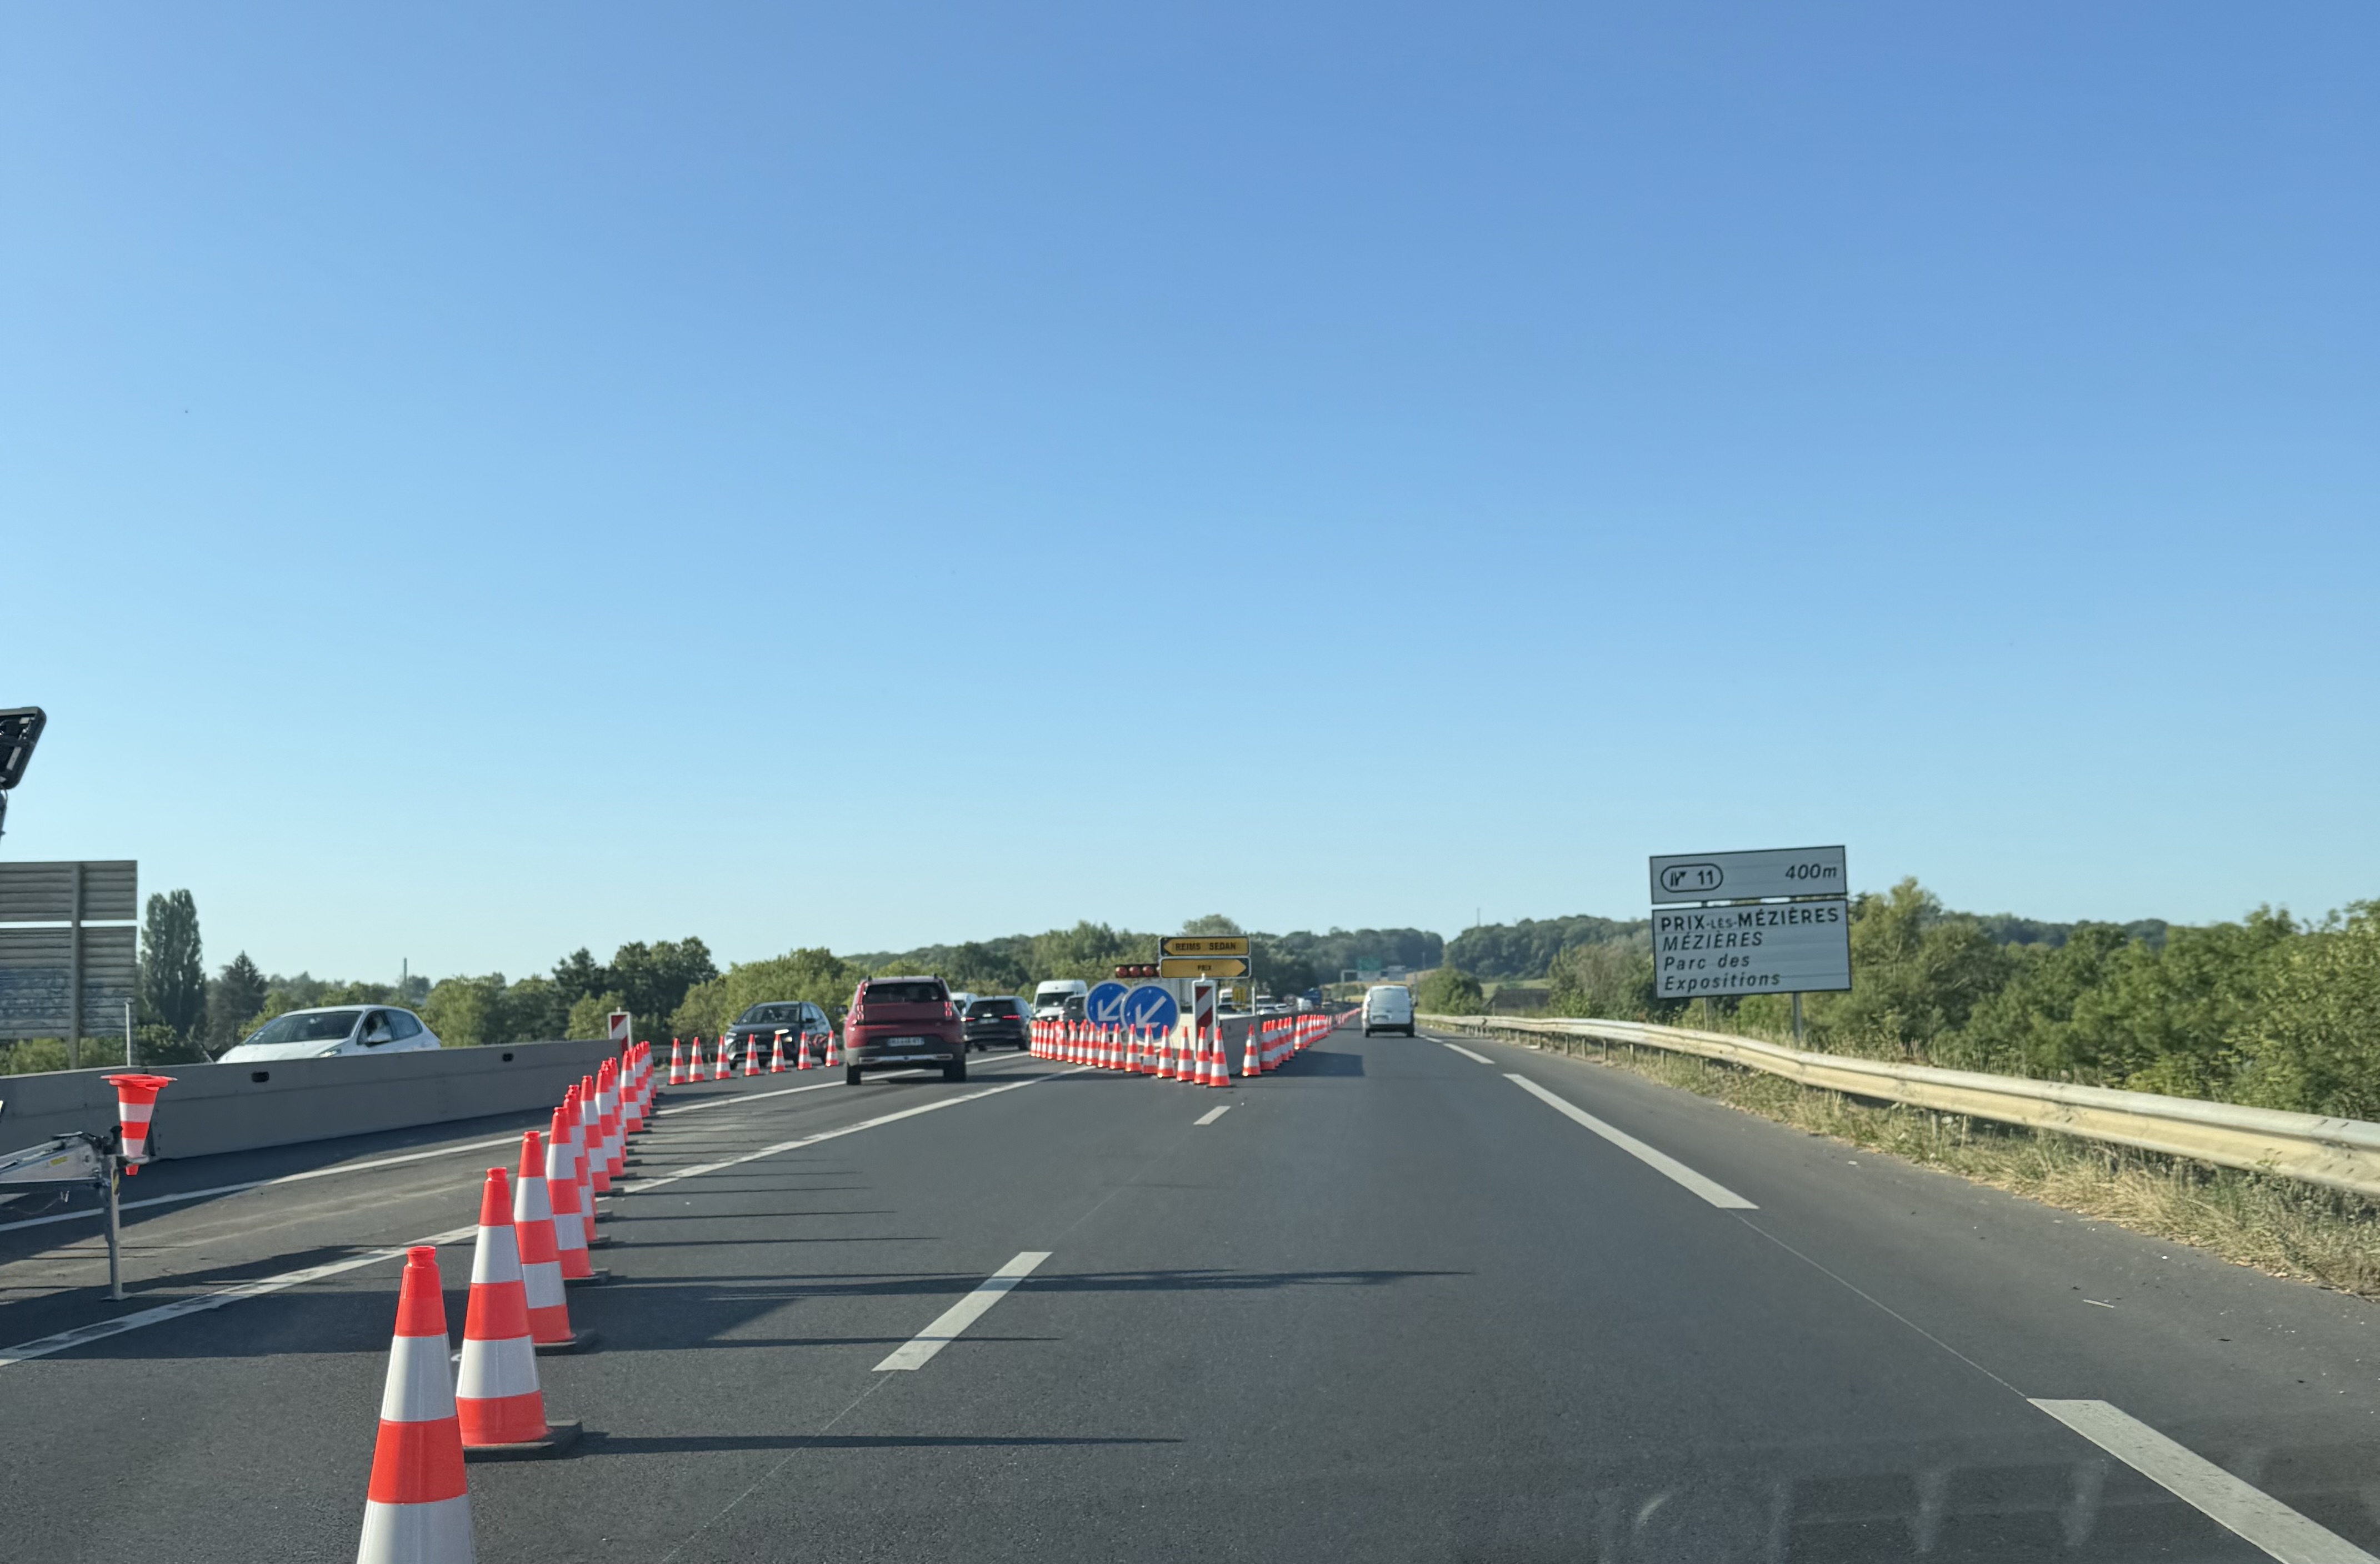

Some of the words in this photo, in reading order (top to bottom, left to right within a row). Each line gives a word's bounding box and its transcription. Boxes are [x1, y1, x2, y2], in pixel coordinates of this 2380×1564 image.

[1698, 870, 1714, 886] 11
[1785, 863, 1837, 880] 400m
[1175, 942, 1201, 951] REIMS
[1209, 942, 1236, 950] SEDAN
[1662, 930, 1763, 952] MÉZIÈRES
[1664, 956, 1707, 971] Parc
[1718, 953, 1750, 968] des
[1664, 972, 1781, 993] Expositions
